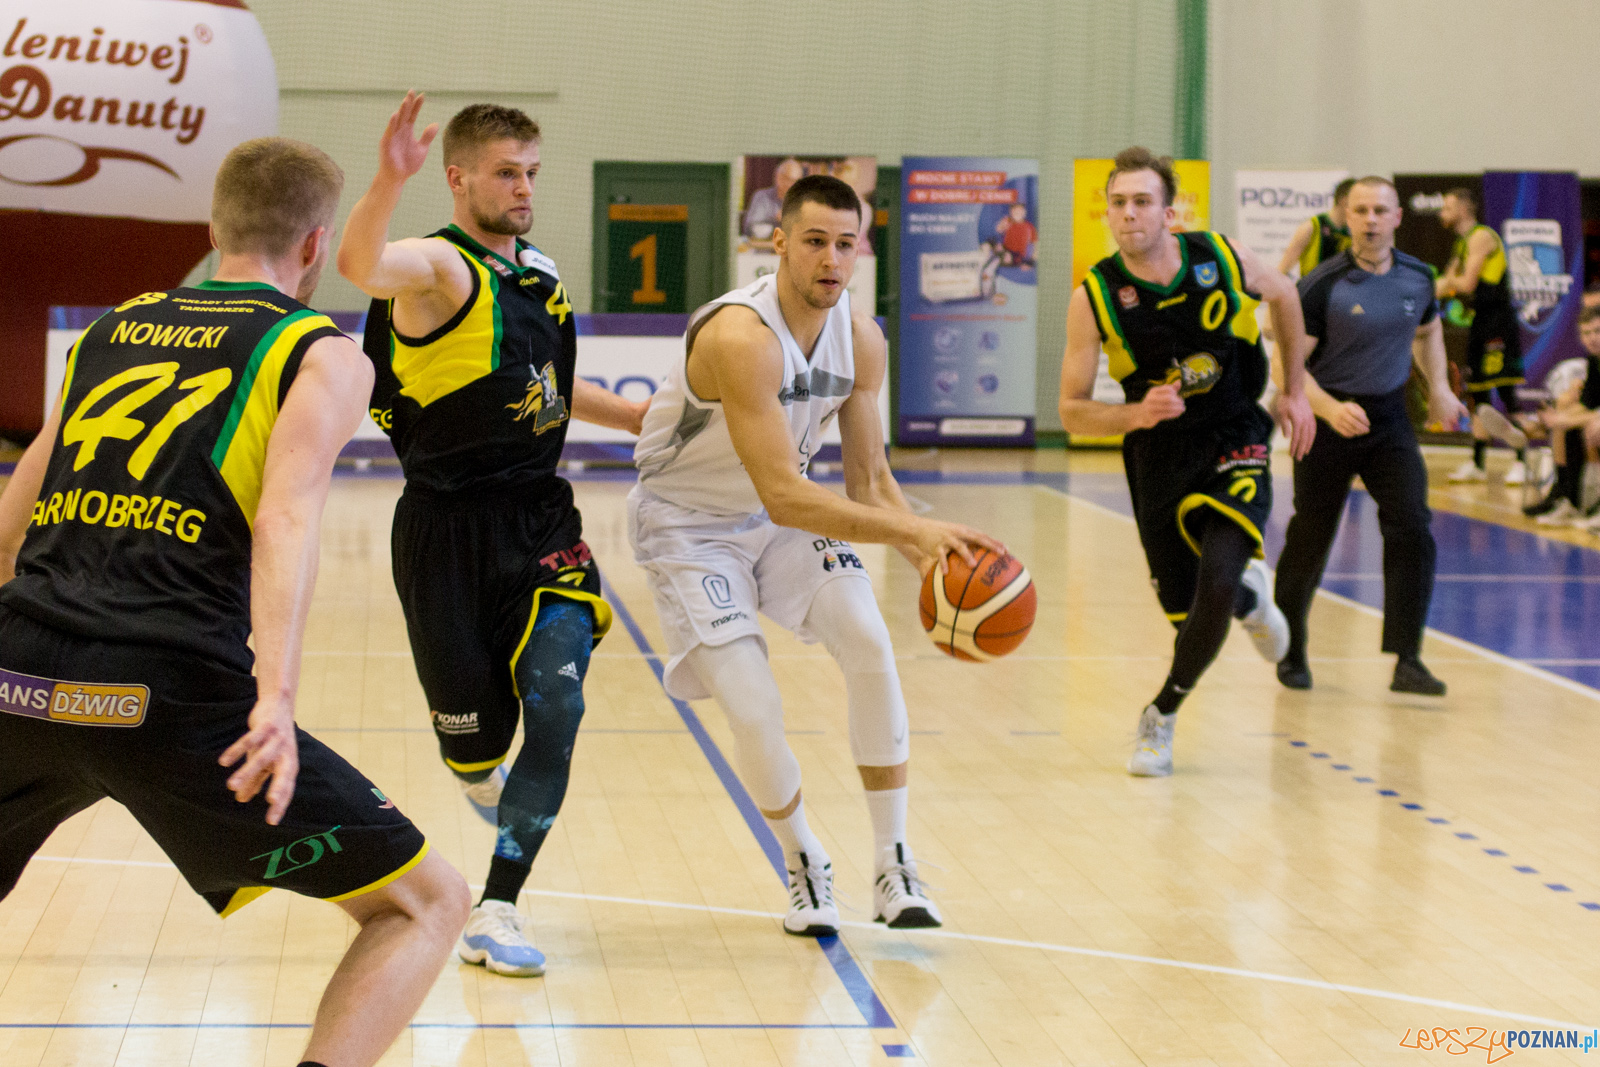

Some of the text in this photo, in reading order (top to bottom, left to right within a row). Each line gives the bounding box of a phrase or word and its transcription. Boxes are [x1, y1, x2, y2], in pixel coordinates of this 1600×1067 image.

[3, 17, 190, 85] leniwej
[0, 64, 206, 145] Danuty
[630, 234, 667, 304] 1
[179, 305, 255, 313] TARNOBRZEG
[224, 298, 288, 315] CHEMICZNE
[545, 281, 572, 325] 4
[110, 320, 229, 348] NOWICKI
[63, 361, 232, 481] 41
[539, 541, 591, 571] TUZ
[53, 688, 140, 717] DŹWIG
[250, 825, 343, 879] ZOT
